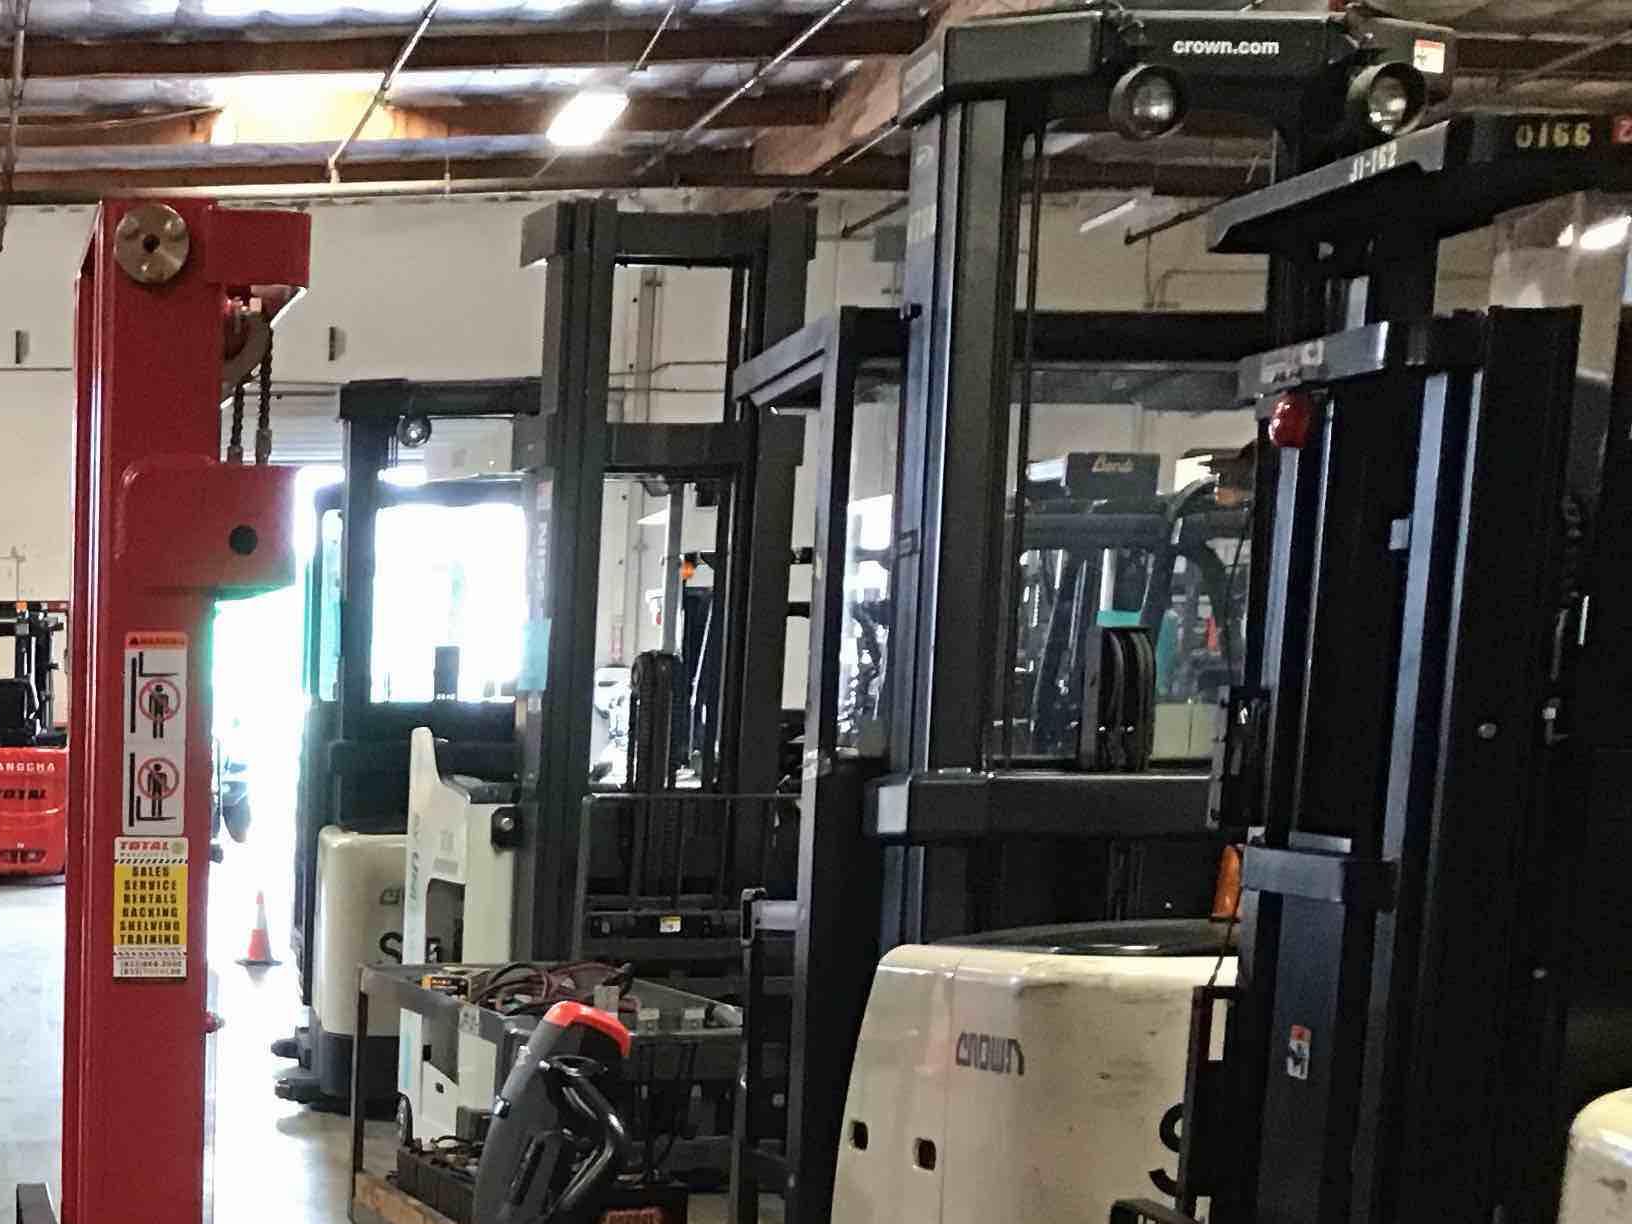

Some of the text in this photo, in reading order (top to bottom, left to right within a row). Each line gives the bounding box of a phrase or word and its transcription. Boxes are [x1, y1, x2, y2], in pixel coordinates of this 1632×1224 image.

[1172, 40, 1280, 54] crown.com
[1516, 123, 1591, 147] 0166
[120, 841, 168, 850] TOTAL
[124, 880, 176, 890] SERVICE
[123, 894, 176, 904] RENTALS
[120, 920, 180, 931] SHELVING
[120, 934, 179, 944] TRAINING
